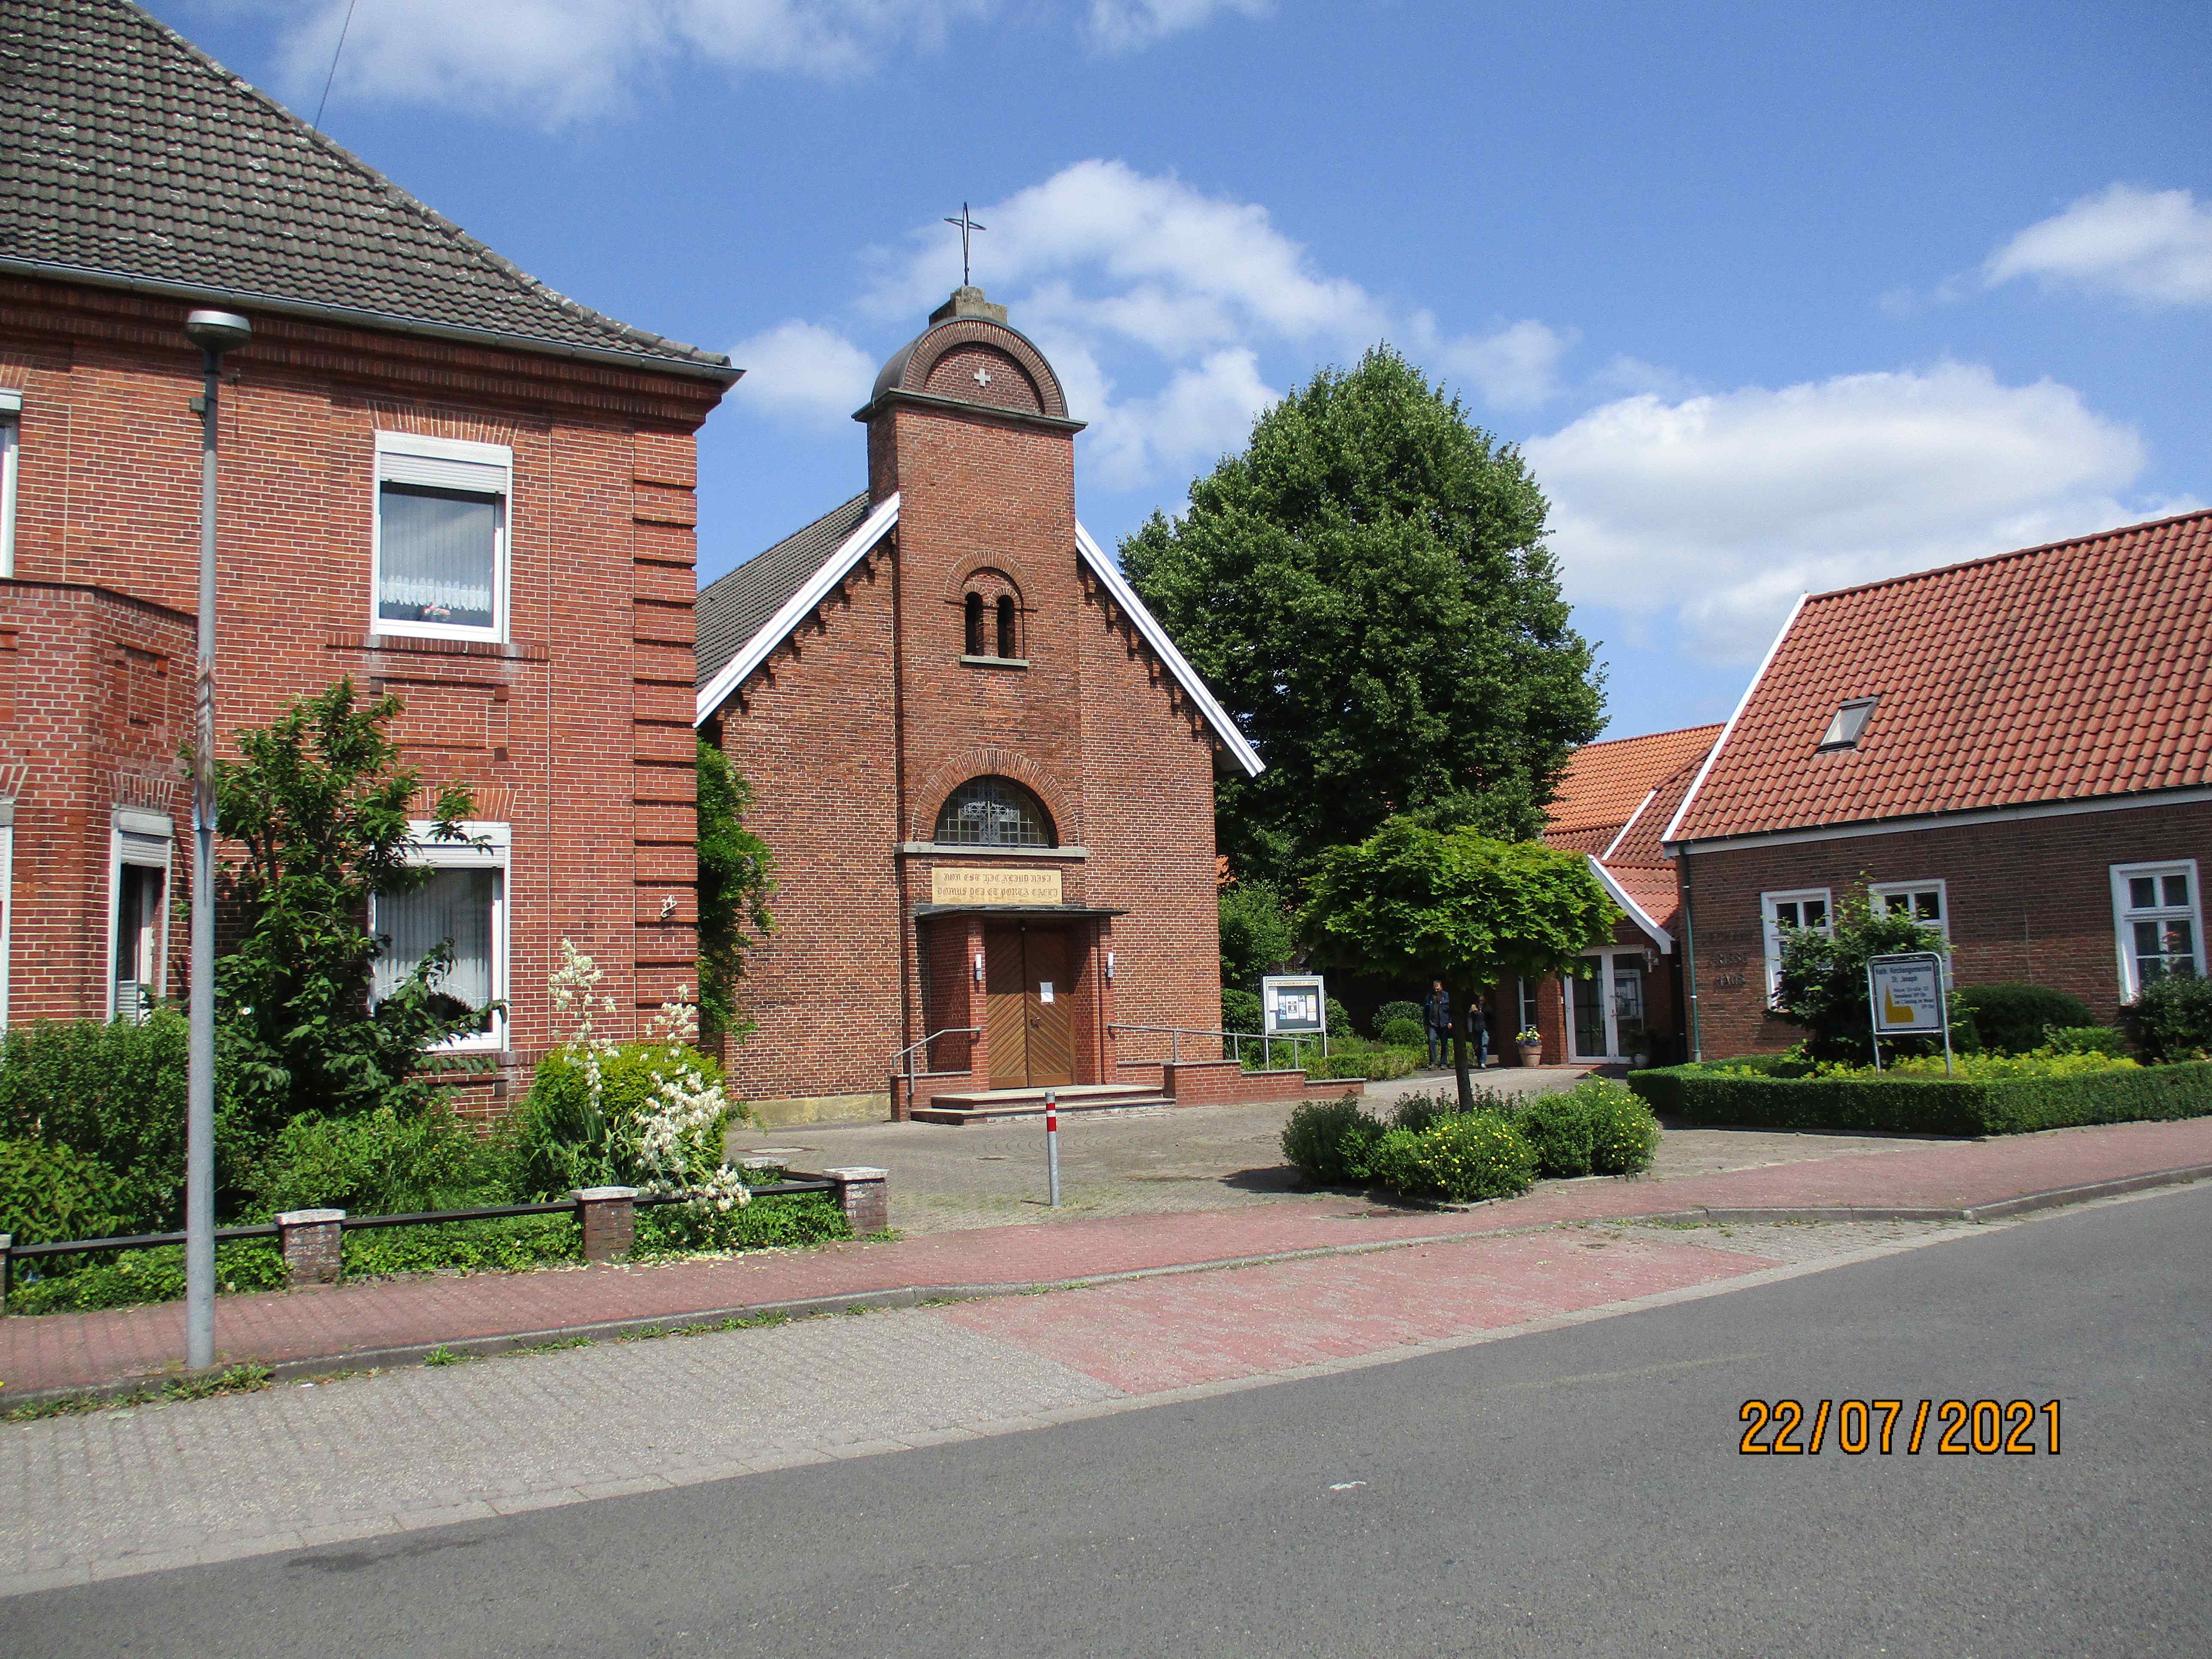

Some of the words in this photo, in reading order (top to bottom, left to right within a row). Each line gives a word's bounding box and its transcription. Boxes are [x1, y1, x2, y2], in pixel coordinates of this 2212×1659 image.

[944, 873, 961, 881] NON
[963, 873, 980, 881] EST
[983, 873, 1000, 884] HIC
[1001, 874, 1029, 884] ALIUD
[937, 887, 967, 897] DOMUS
[969, 887, 985, 897] DEI
[987, 887, 999, 896] ET
[1000, 887, 1029, 897] PORTA
[1031, 888, 1058, 898] CAELI
[661, 895, 674, 910] 34
